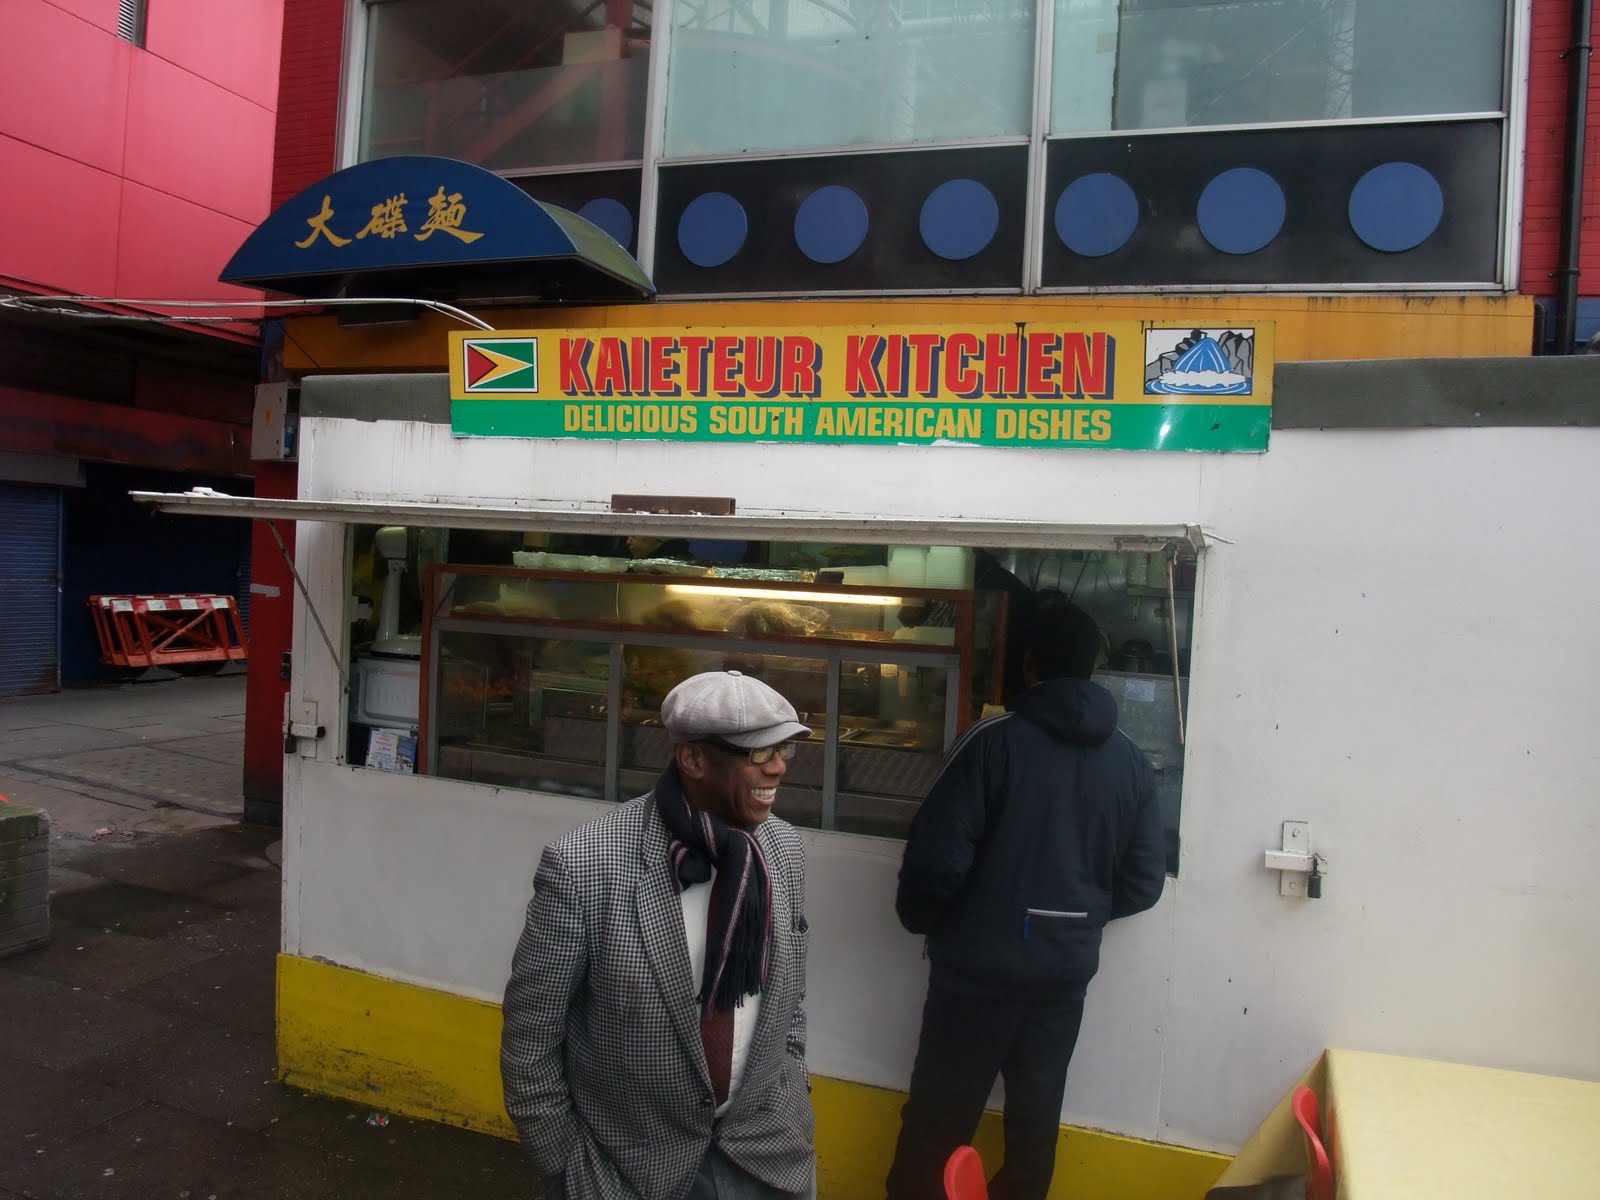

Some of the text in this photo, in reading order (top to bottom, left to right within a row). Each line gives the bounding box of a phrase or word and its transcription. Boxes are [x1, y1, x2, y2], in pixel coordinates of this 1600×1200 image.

[295, 186, 485, 249] 大碟麵
[559, 331, 1114, 399] KAIETEUR KITCHEN
[564, 404, 1112, 441] DELICIOUS SOUTH AMERICAN DISHES
